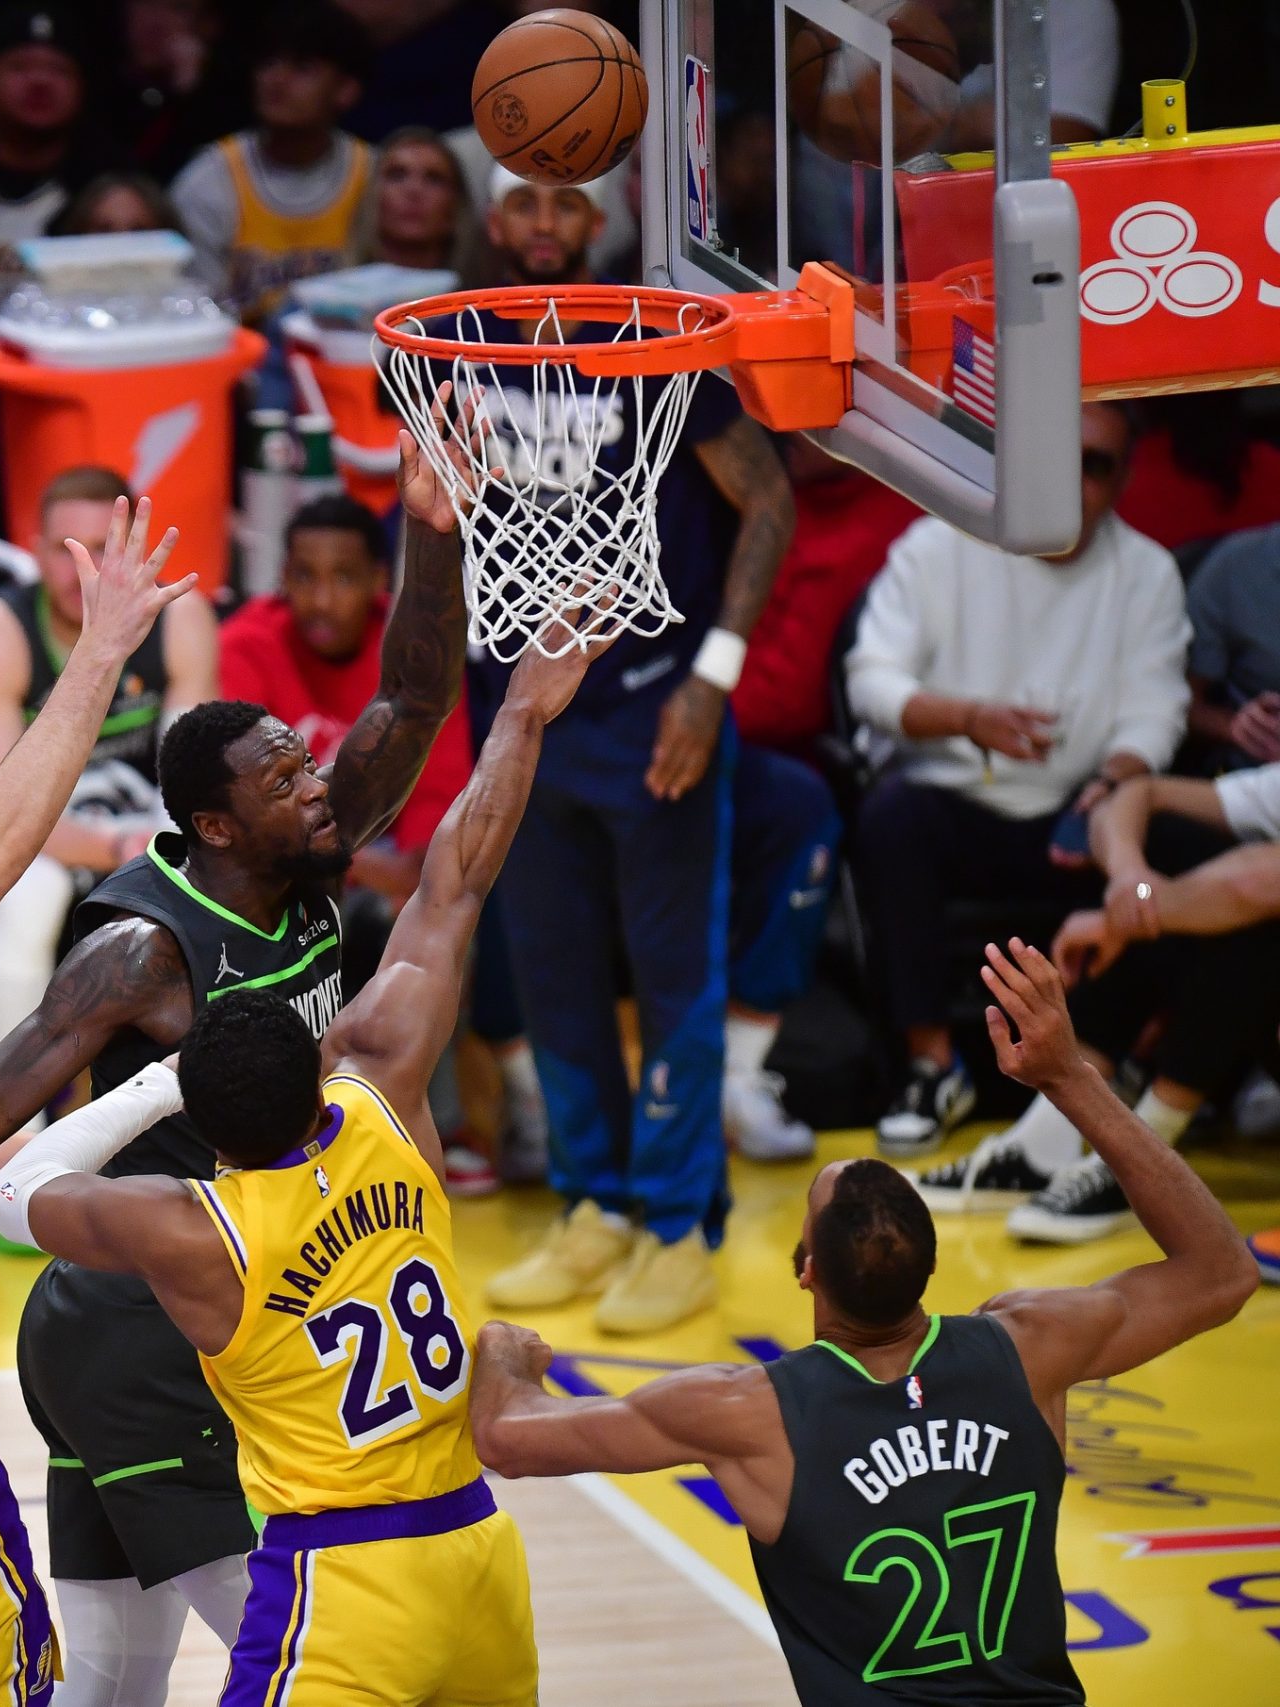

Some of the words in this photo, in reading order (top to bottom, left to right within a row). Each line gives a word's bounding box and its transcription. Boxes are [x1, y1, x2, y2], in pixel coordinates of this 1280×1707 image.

[263, 1180, 425, 1318] HACHIMURA
[302, 1254, 471, 1450] 28
[843, 1418, 1010, 1504] GOBERT
[843, 1490, 1037, 1683] 27
